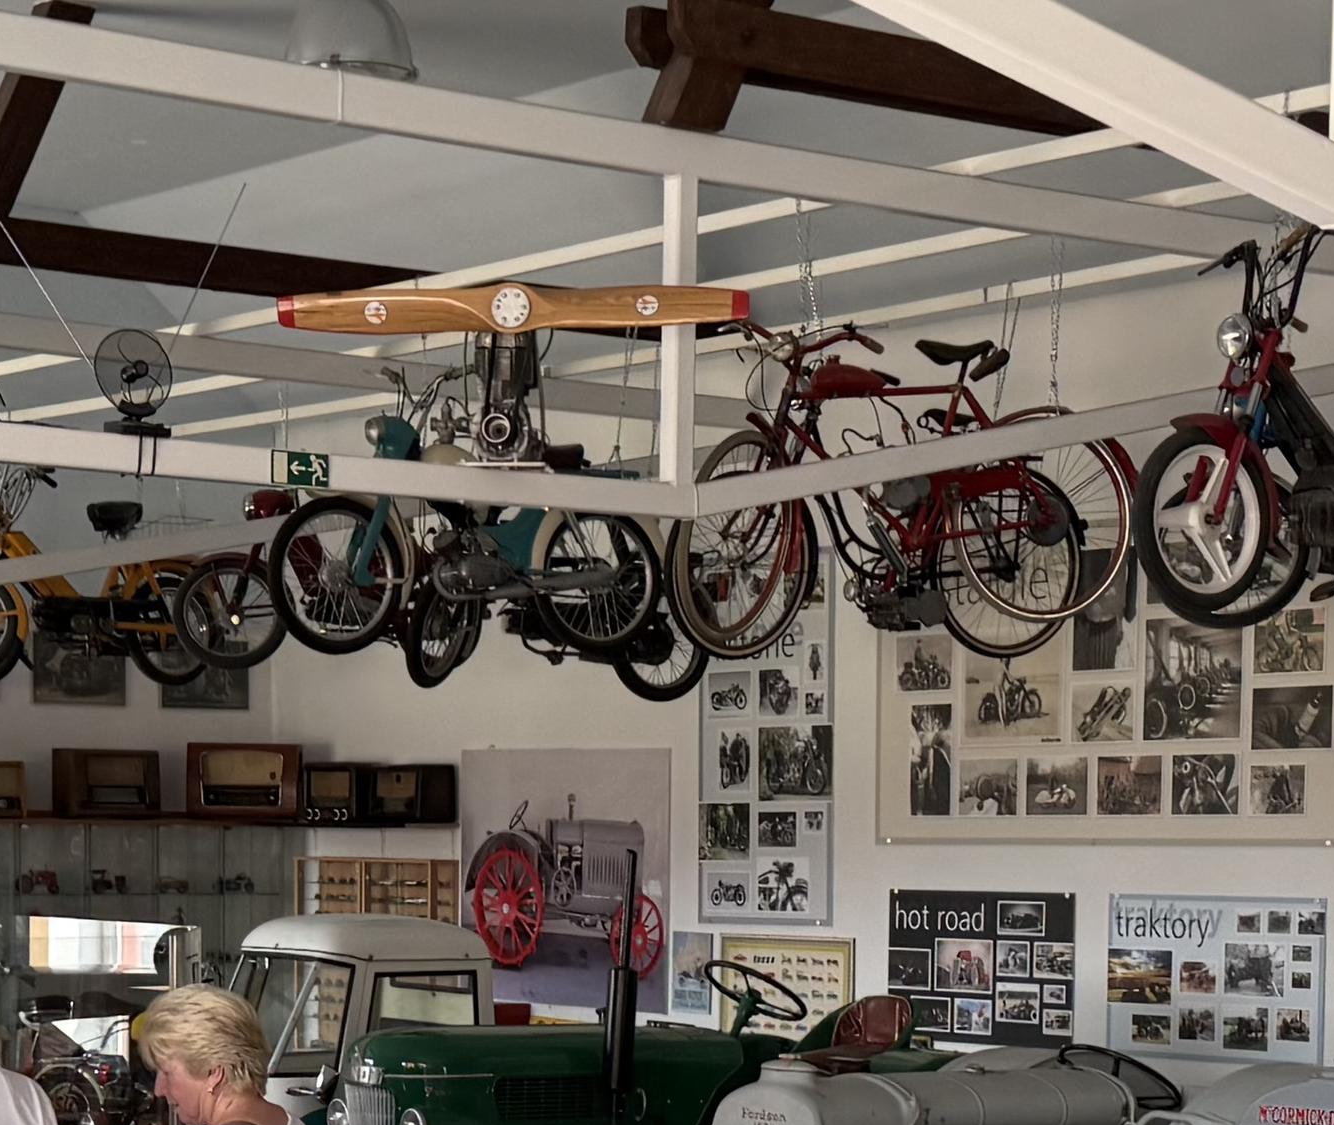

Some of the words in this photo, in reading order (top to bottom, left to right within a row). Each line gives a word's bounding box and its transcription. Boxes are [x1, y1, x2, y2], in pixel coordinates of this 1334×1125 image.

[895, 900, 929, 930] hot
[937, 903, 985, 932] road
[1115, 908, 1210, 948] traktory
[742, 1106, 787, 1122] Fordson
